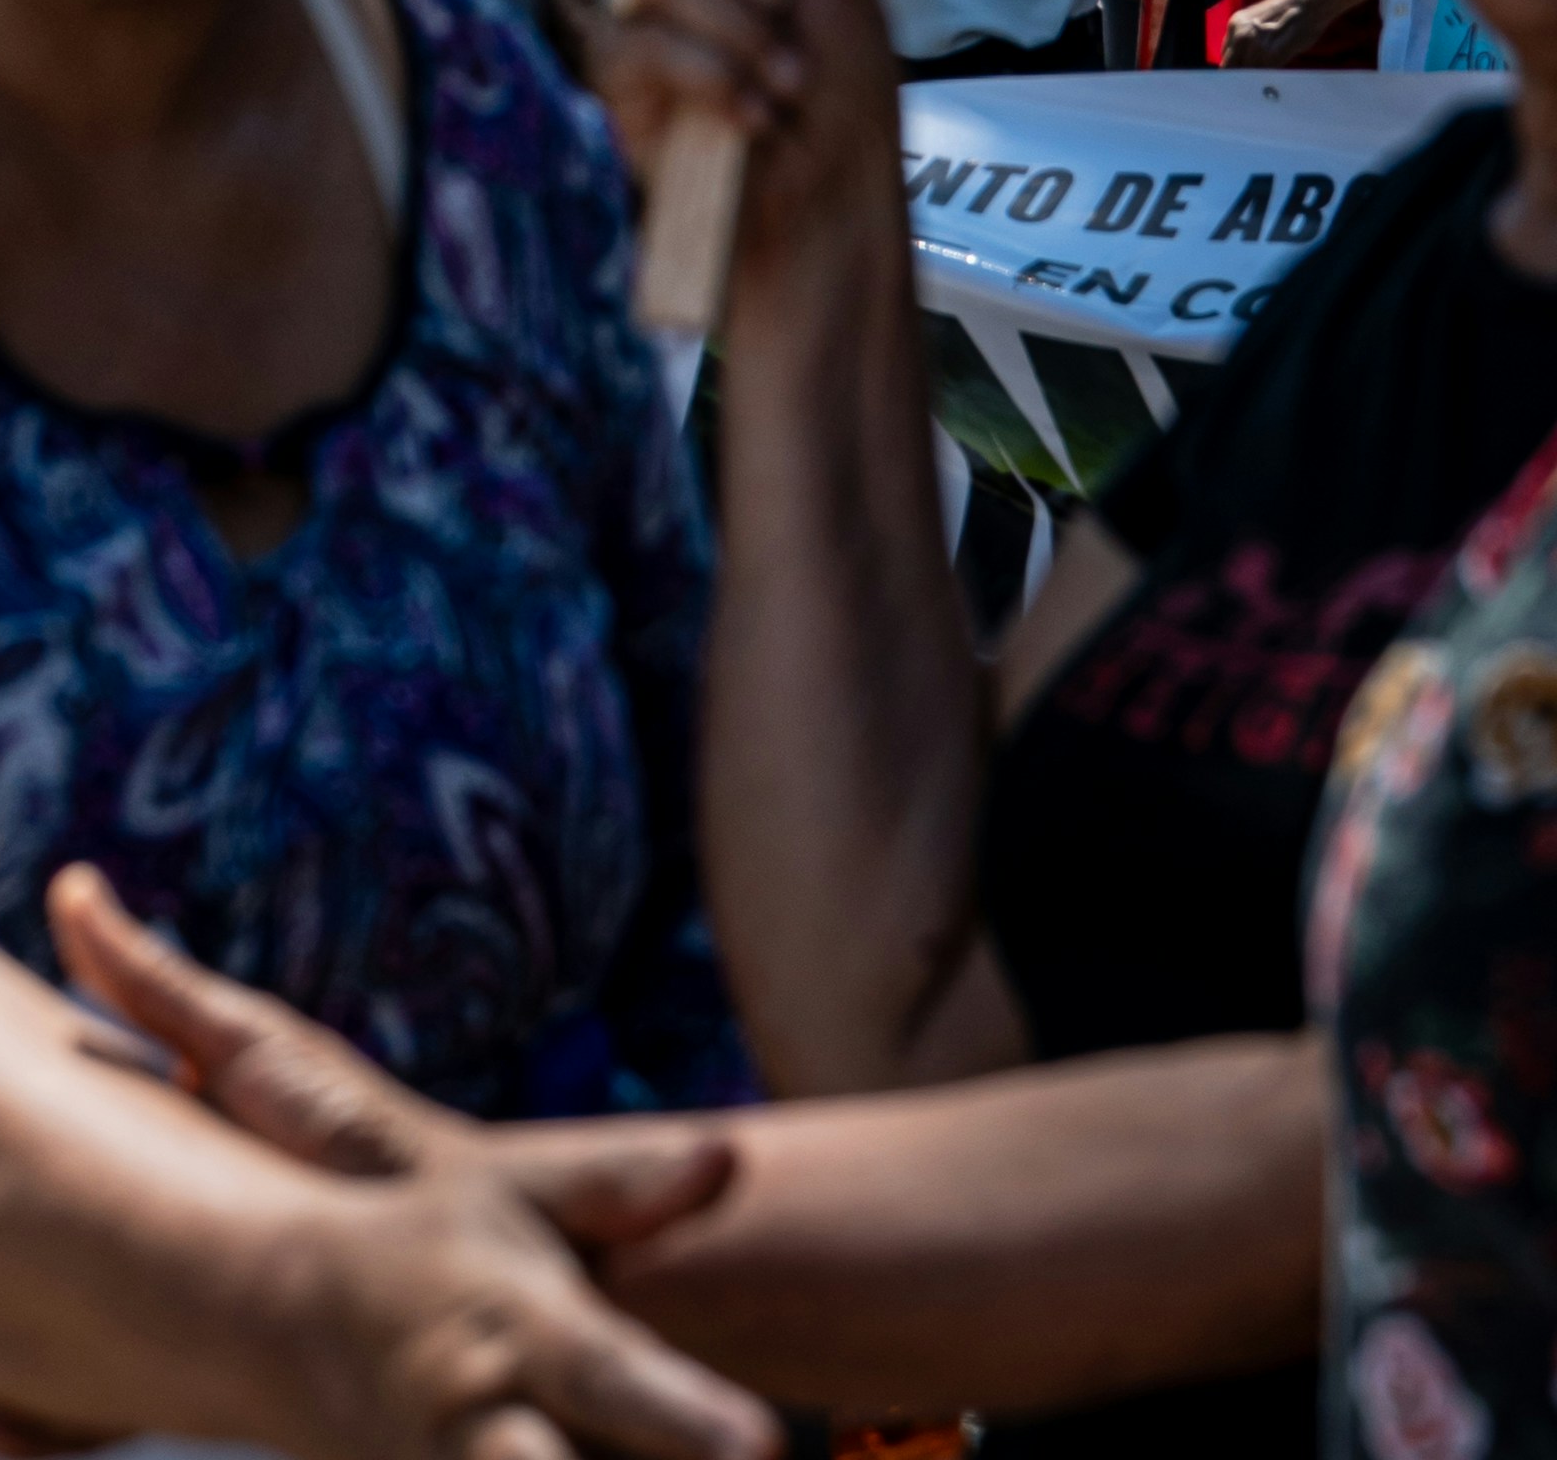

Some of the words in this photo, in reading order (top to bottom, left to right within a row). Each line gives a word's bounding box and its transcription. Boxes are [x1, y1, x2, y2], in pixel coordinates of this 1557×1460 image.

[901, 150, 1075, 224] NTO
[1084, 171, 1206, 240] DE
[1013, 257, 1153, 307] EN
